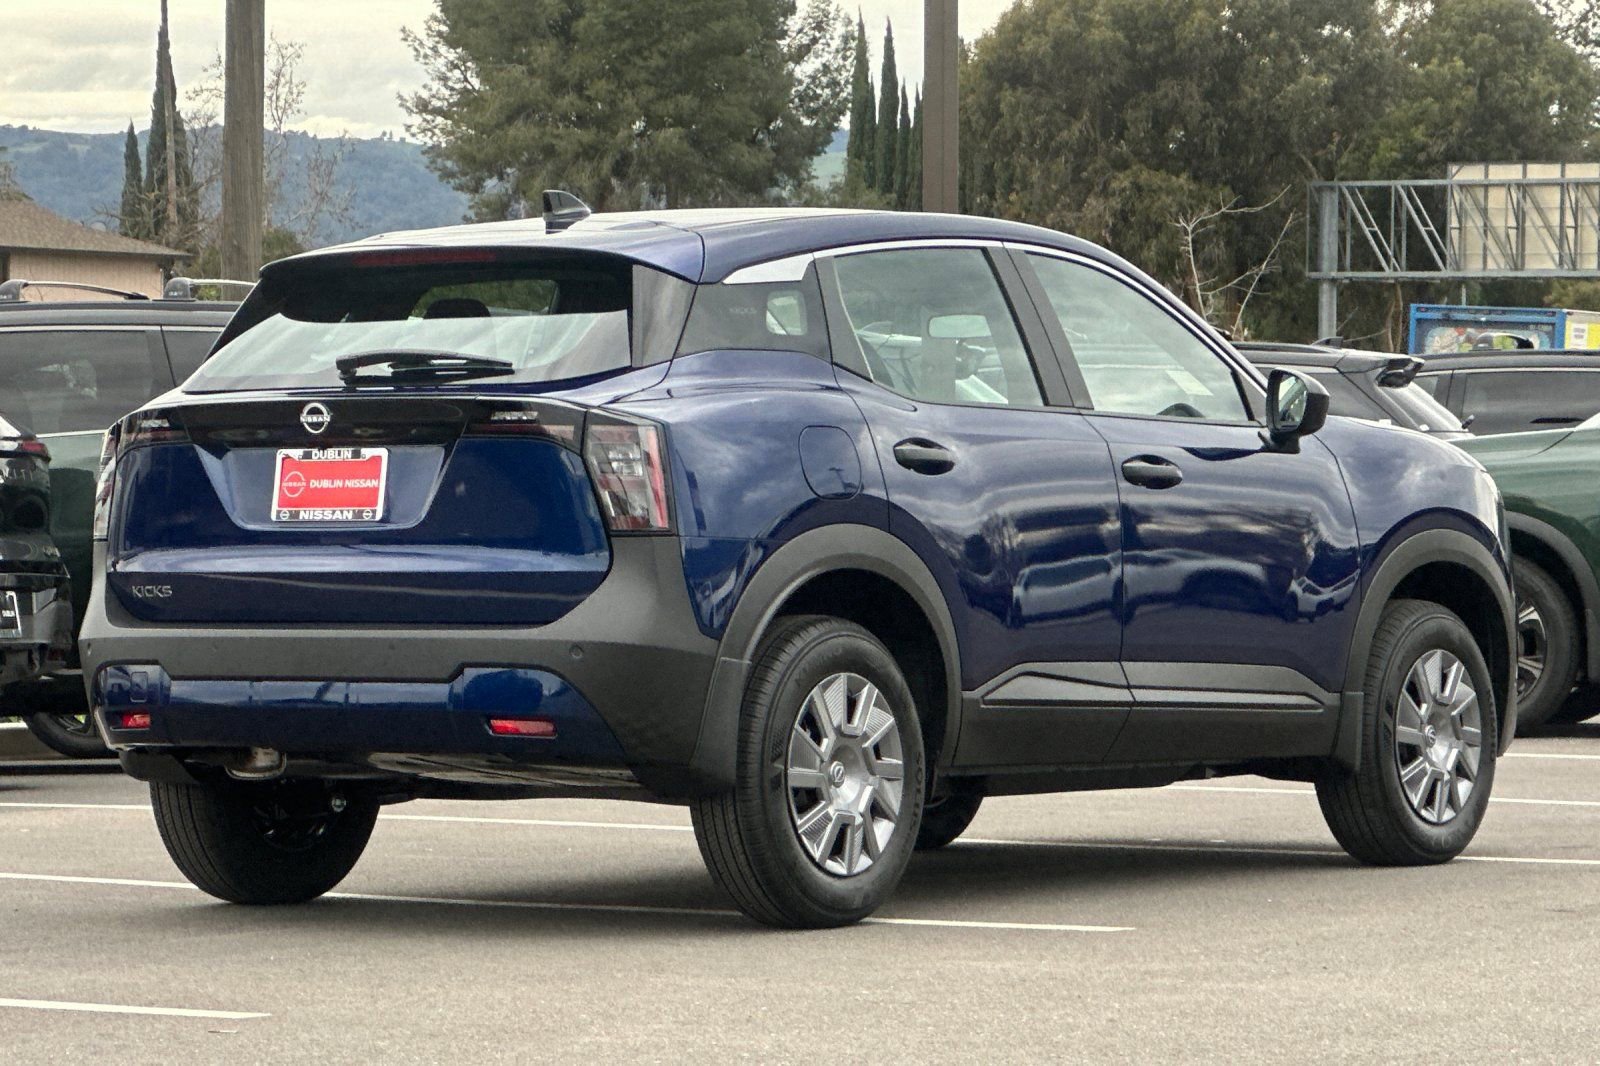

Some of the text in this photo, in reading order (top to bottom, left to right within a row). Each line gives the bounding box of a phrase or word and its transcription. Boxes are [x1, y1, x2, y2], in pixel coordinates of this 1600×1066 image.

[300, 415, 330, 423] NISSAN
[311, 449, 352, 460] DUBLIN
[310, 479, 379, 489] DUBLIN NISSAN
[299, 509, 354, 520] NISSAN
[132, 585, 173, 598] KICKS
